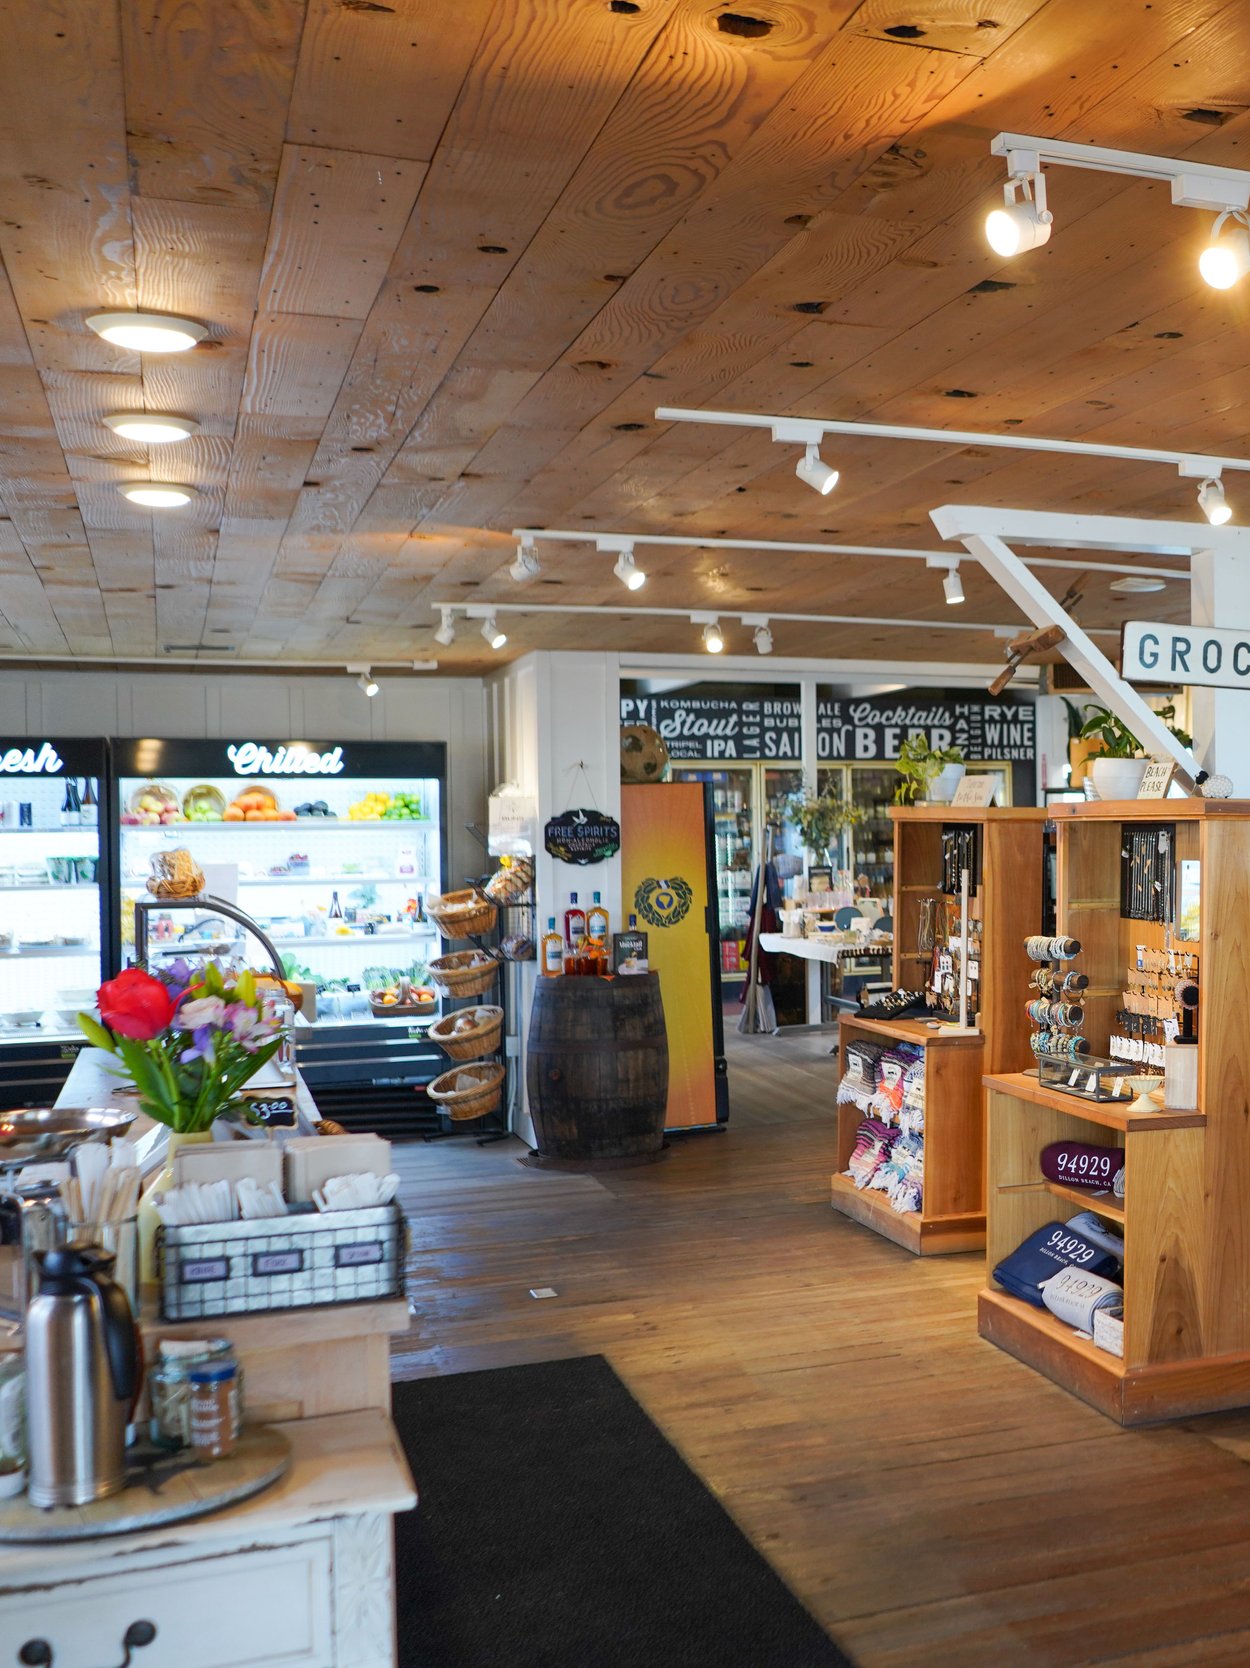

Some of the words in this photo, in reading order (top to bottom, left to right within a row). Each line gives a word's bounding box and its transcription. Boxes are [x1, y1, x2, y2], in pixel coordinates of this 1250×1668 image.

[660, 700, 738, 709] KOMBUCHA
[763, 701, 801, 715] BROW
[818, 702, 841, 716] ALE
[849, 702, 954, 726] Cocktails
[984, 705, 1034, 721] RYE
[659, 709, 740, 737] Stout
[743, 702, 760, 758] LAGER
[764, 731, 846, 758] SAION
[984, 723, 1034, 746] WINE
[227, 742, 345, 775] Chilled
[706, 739, 737, 758] IPA
[984, 747, 1034, 760] PILSNER
[1145, 766, 1168, 778] BEACH
[1139, 781, 1164, 792] PLEASE
[548, 826, 574, 837] FREE
[577, 826, 618, 838] SPIRITS
[1057, 1152, 1111, 1177] 94929
[1058, 1174, 1080, 1183] DILLON
[1047, 1230, 1095, 1263] 94929
[1056, 1274, 1103, 1299] 94929
